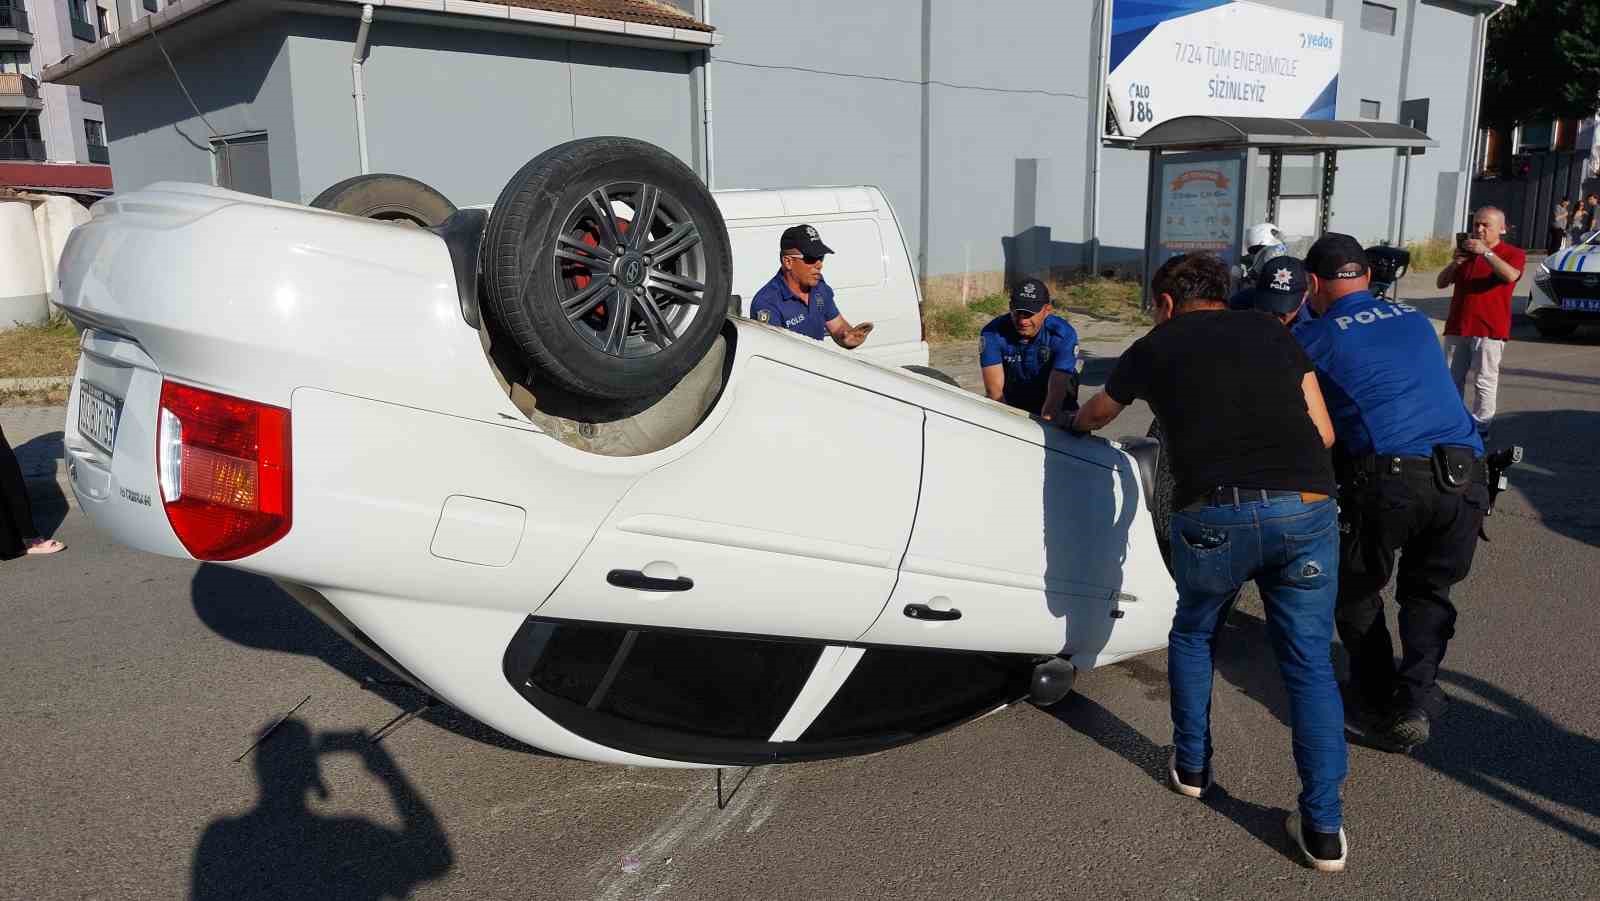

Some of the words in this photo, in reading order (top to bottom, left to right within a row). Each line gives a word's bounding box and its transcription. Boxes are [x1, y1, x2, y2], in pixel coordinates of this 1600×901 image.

[1175, 42, 1201, 64] 7/24
[1204, 40, 1232, 67] TÜM
[1135, 84, 1150, 98] ALO
[1129, 100, 1153, 122] 186
